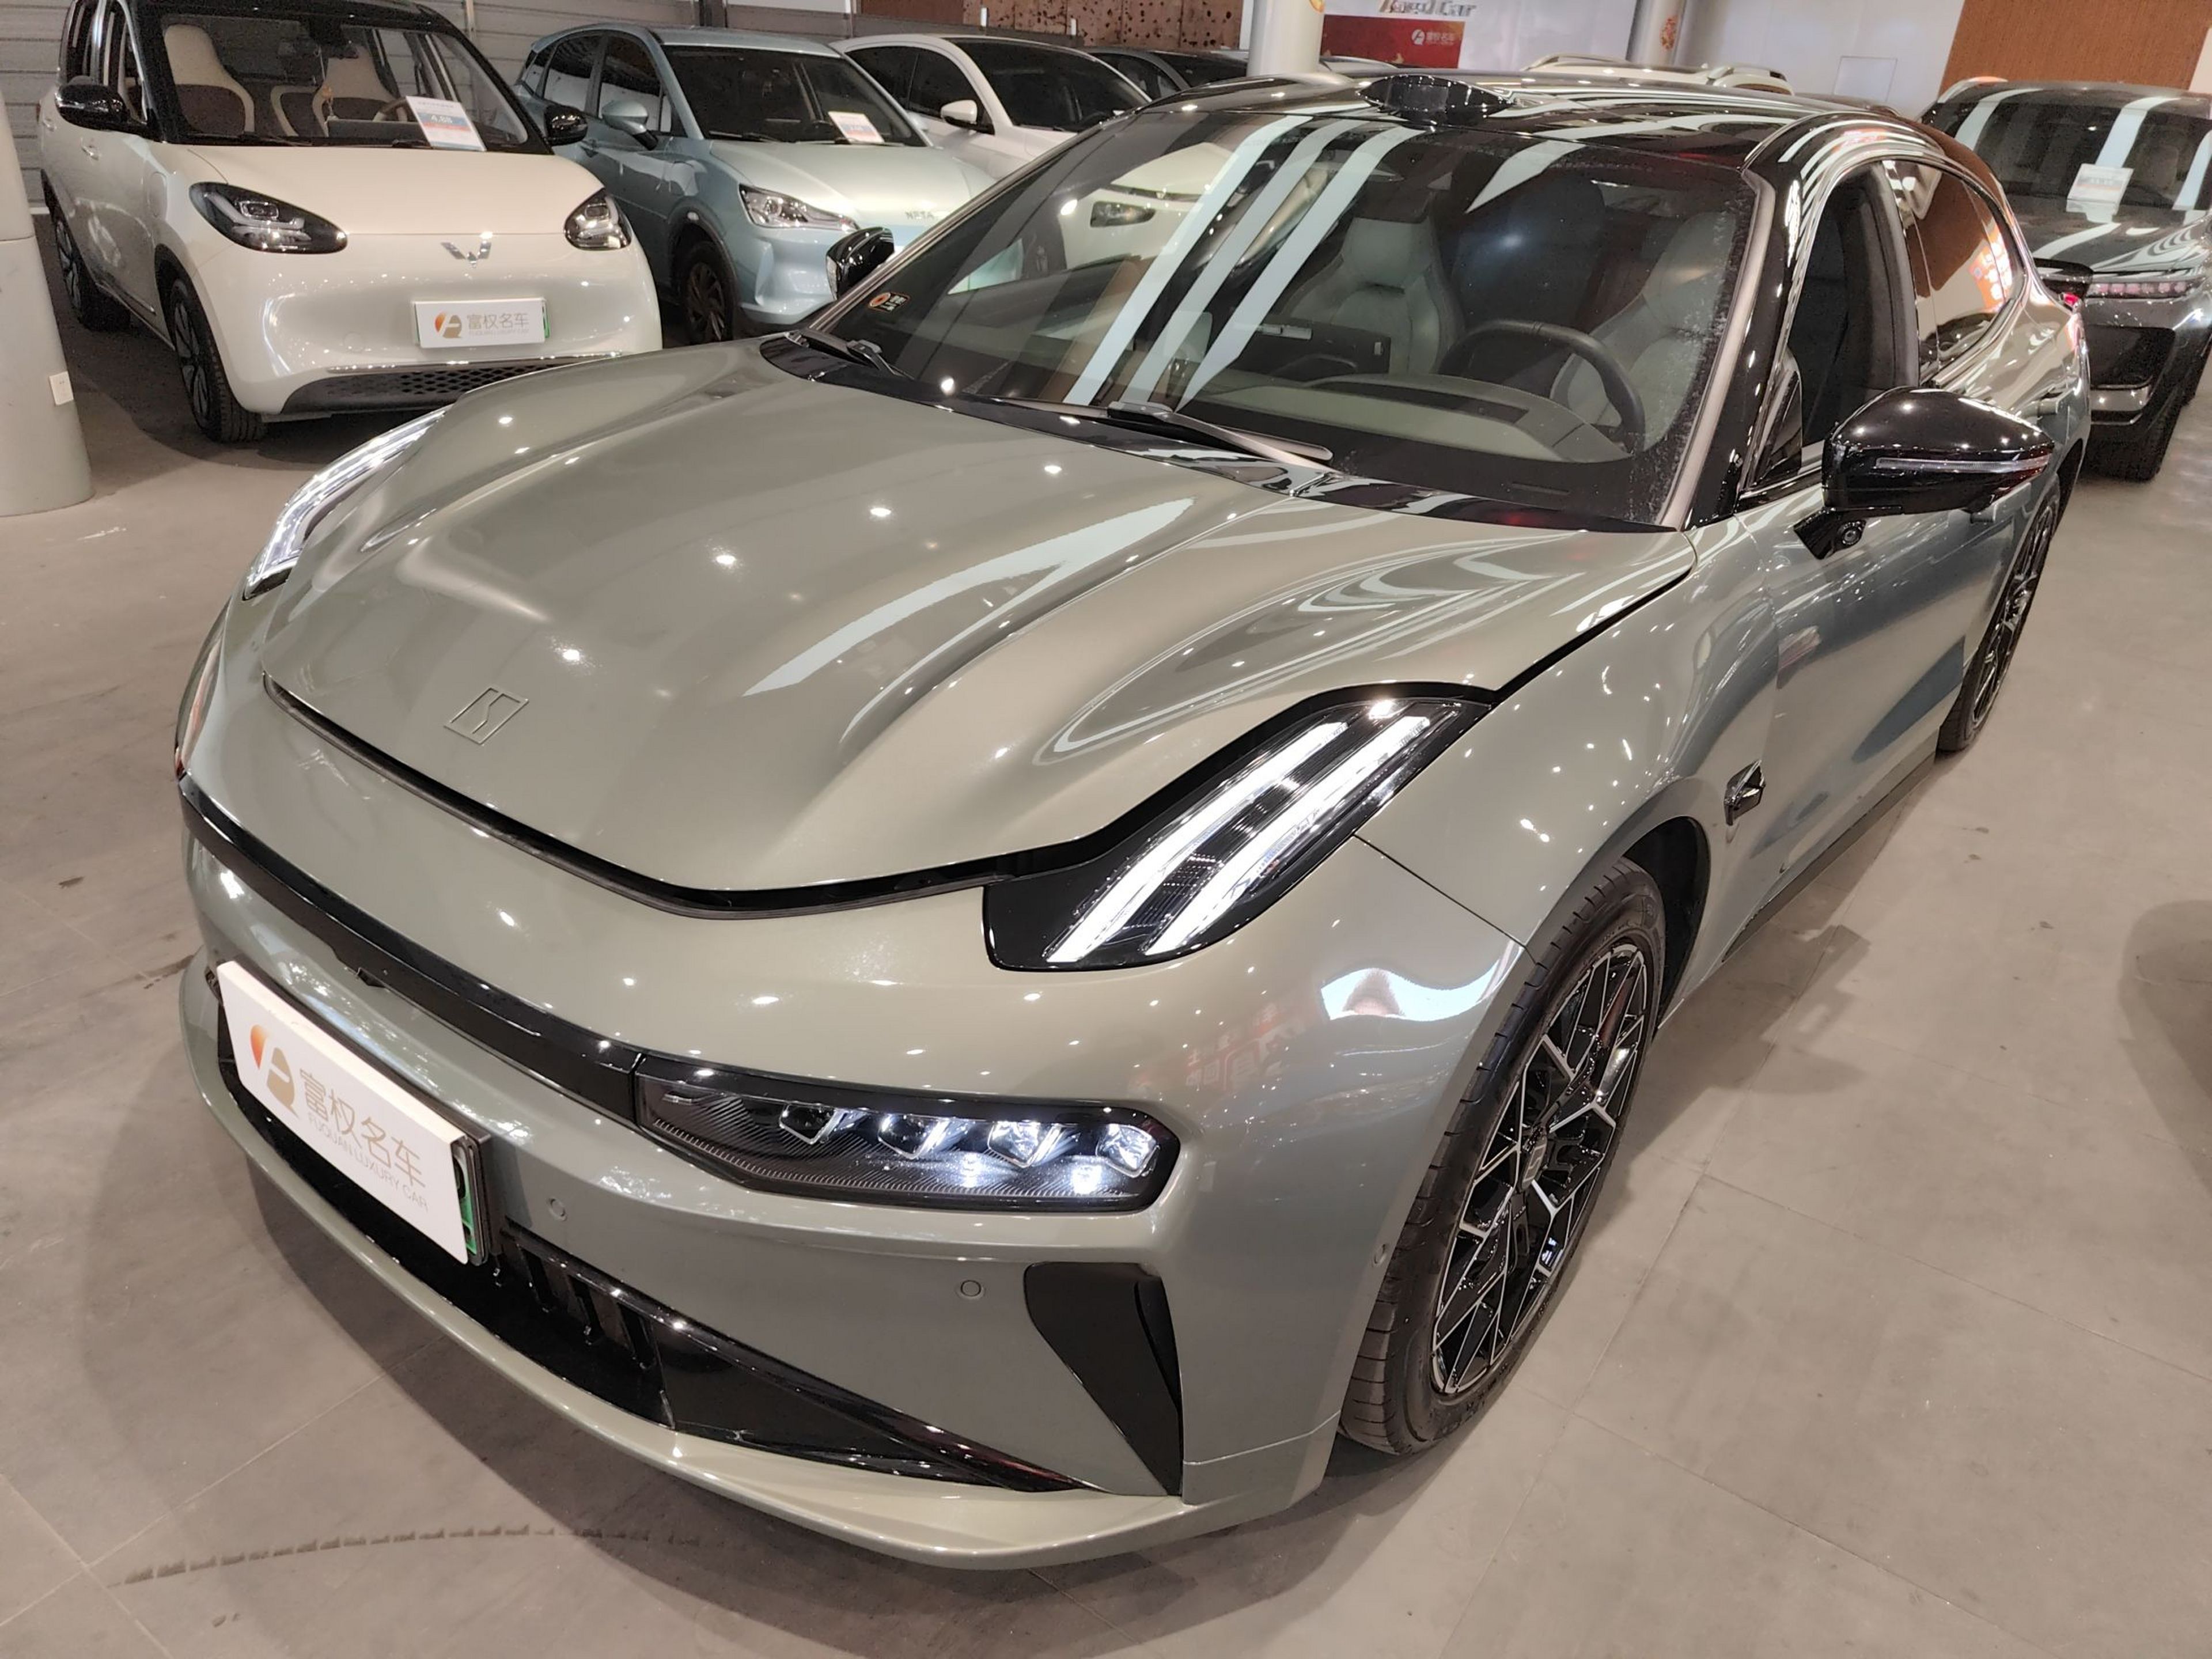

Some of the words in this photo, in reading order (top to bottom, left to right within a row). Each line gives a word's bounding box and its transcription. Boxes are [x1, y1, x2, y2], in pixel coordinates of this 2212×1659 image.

[467, 312, 529, 330] 富权名车
[300, 1068, 426, 1188] 富权名车
[402, 1184, 429, 1213] CAR
